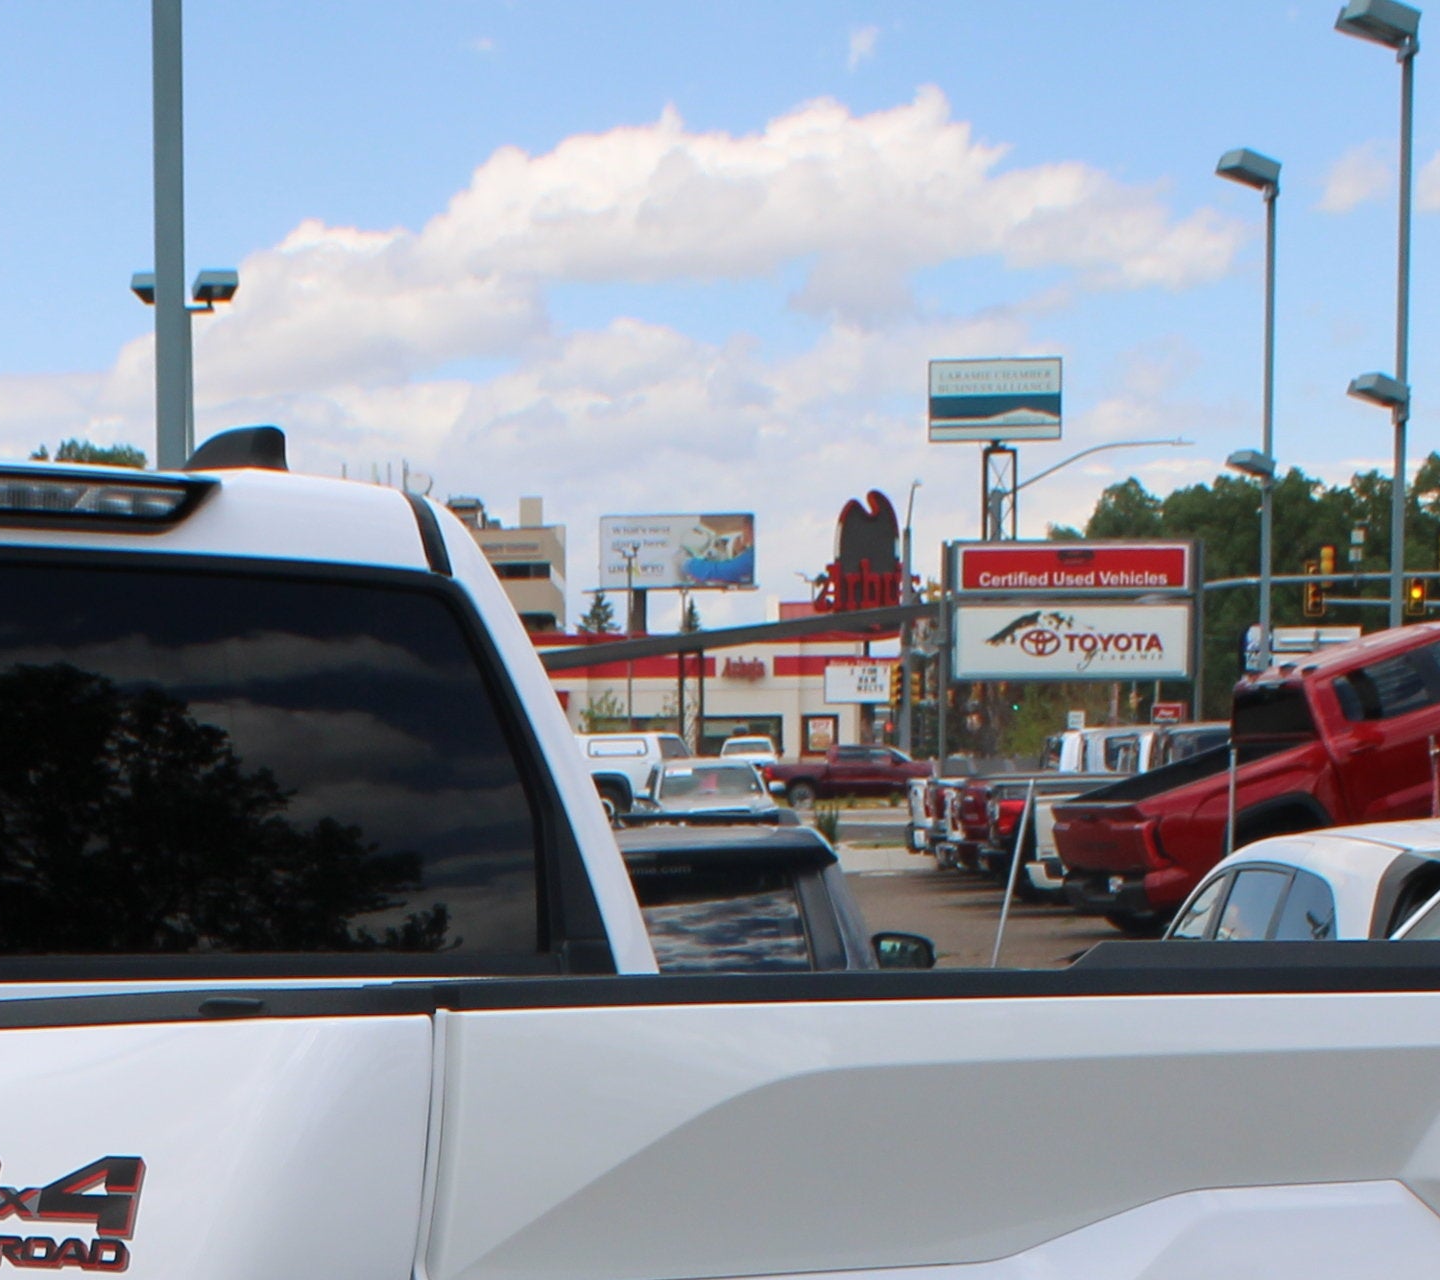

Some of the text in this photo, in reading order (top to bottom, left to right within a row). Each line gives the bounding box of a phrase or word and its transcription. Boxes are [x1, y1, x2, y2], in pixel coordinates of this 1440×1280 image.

[978, 570, 1168, 587] Certified Used Vehicles
[1064, 633, 1164, 652] TOYOTA
